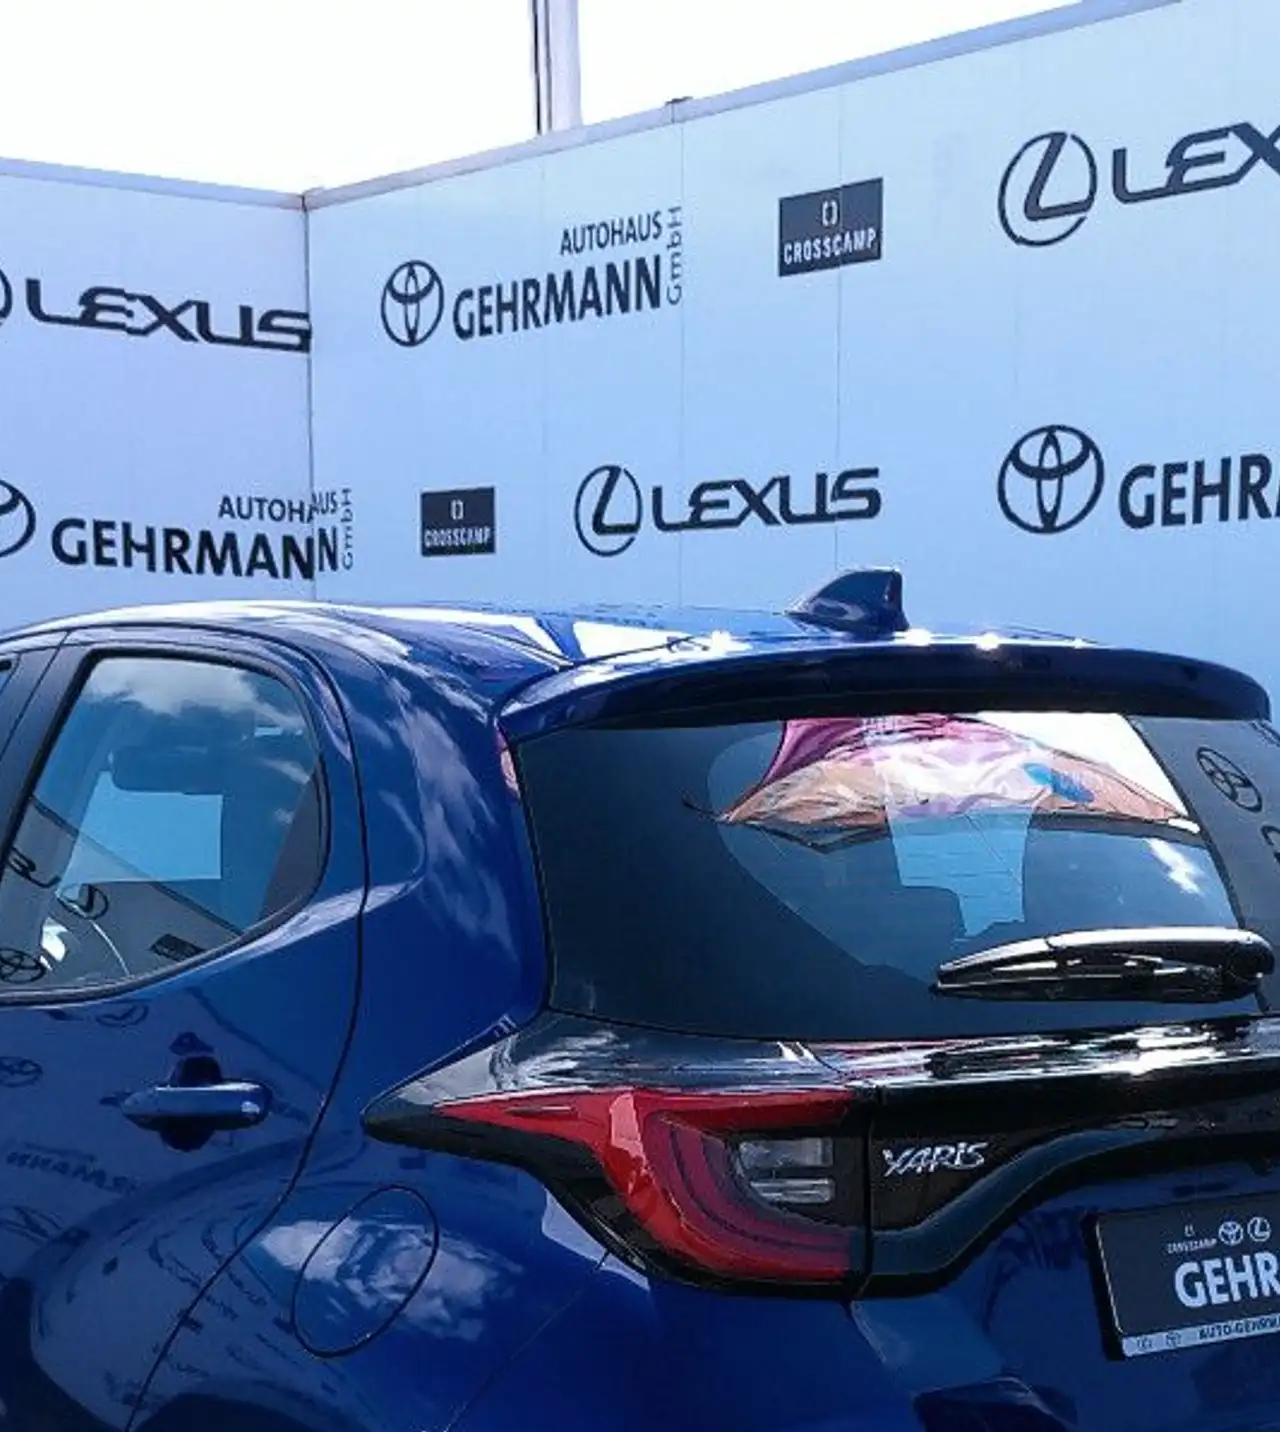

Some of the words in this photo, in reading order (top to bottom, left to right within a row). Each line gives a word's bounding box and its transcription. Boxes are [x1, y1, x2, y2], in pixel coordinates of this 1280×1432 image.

[559, 210, 663, 257] AUTOHAUS
[666, 206, 683, 306] GmbH
[783, 225, 878, 266] CROSSCAMP
[25, 277, 311, 354] LEXUS
[452, 252, 661, 341] GEHRMANN
[218, 490, 337, 524] AUTOHAUS
[651, 467, 882, 533] LEXUS
[51, 517, 338, 580] GEHRMANN
[882, 1142, 988, 1177] YARIS
